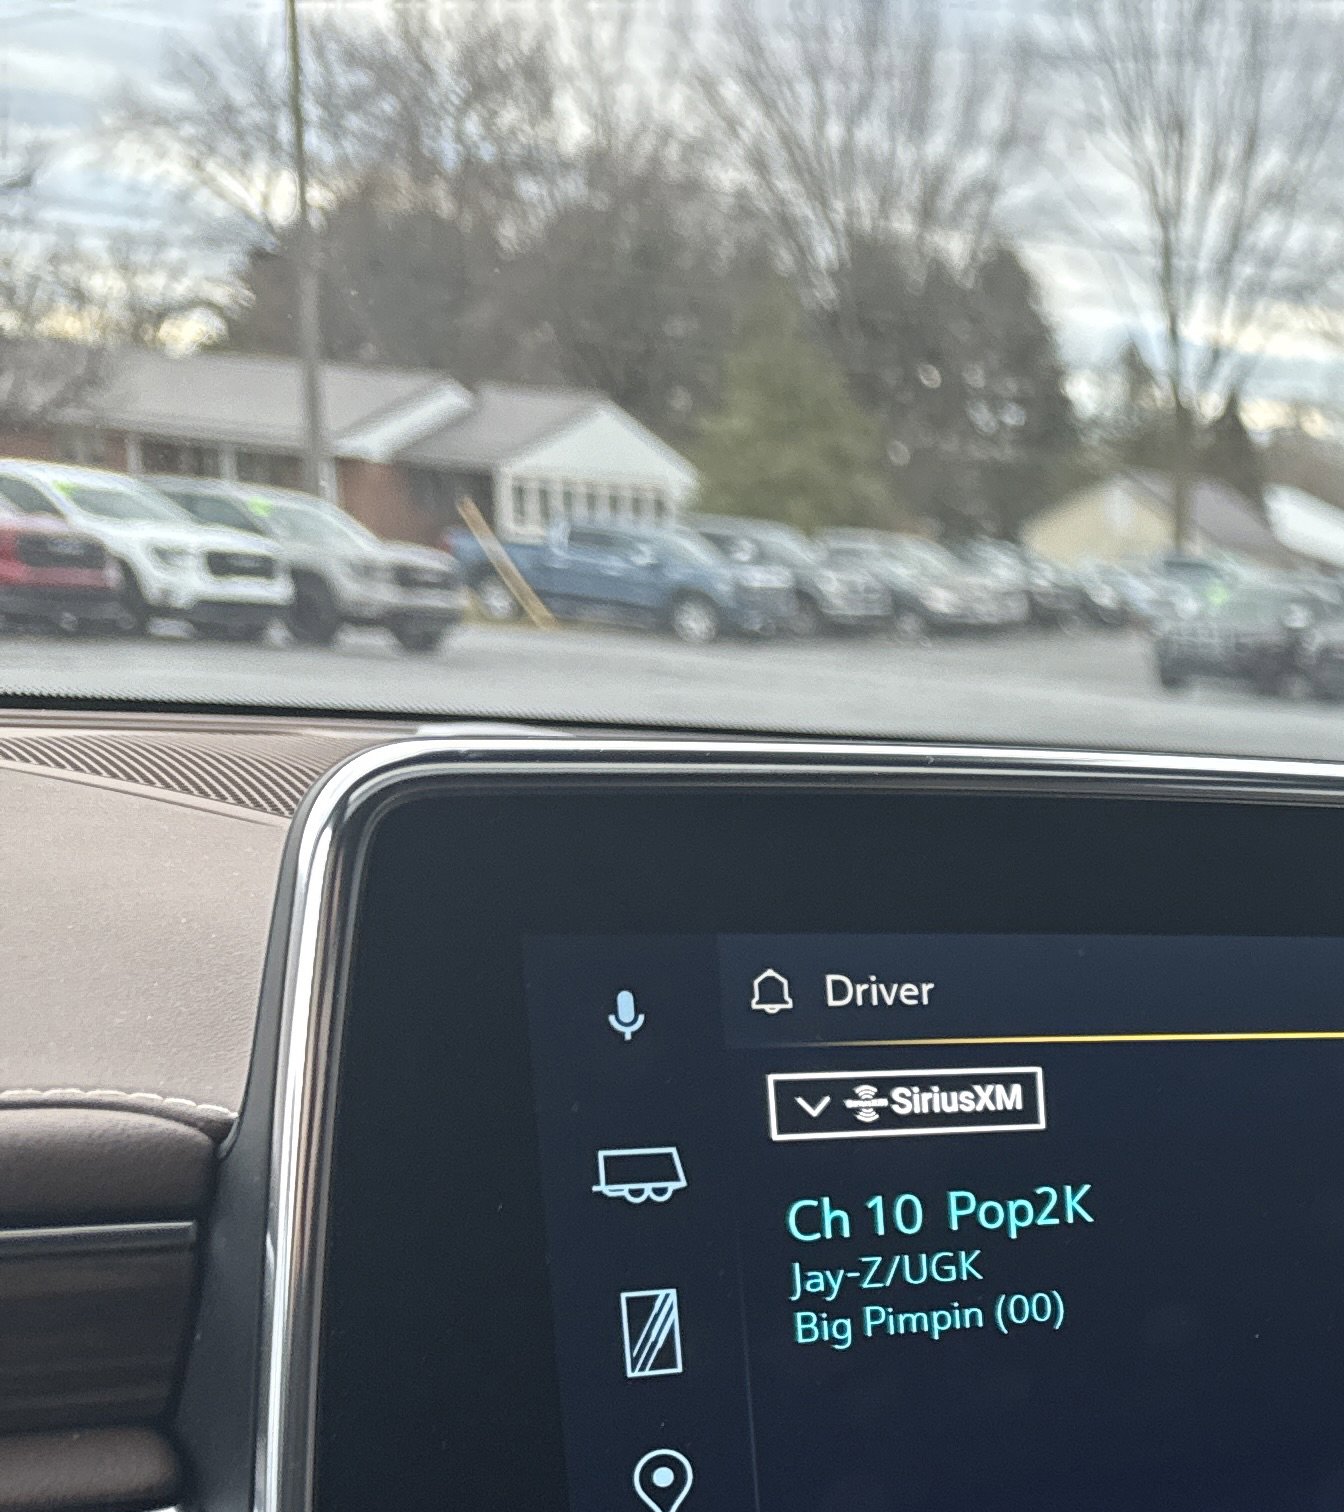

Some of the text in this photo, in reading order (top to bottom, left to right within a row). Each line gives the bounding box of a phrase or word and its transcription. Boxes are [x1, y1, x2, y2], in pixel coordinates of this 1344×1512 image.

[825, 974, 935, 1007] Driver
[890, 1083, 1024, 1115] SiriusXM
[787, 1184, 1095, 1242] Ch 10 Pop2K
[790, 1249, 984, 1302] Jay-Z/UGK
[795, 1290, 1066, 1350] Big Pimpin (00)
